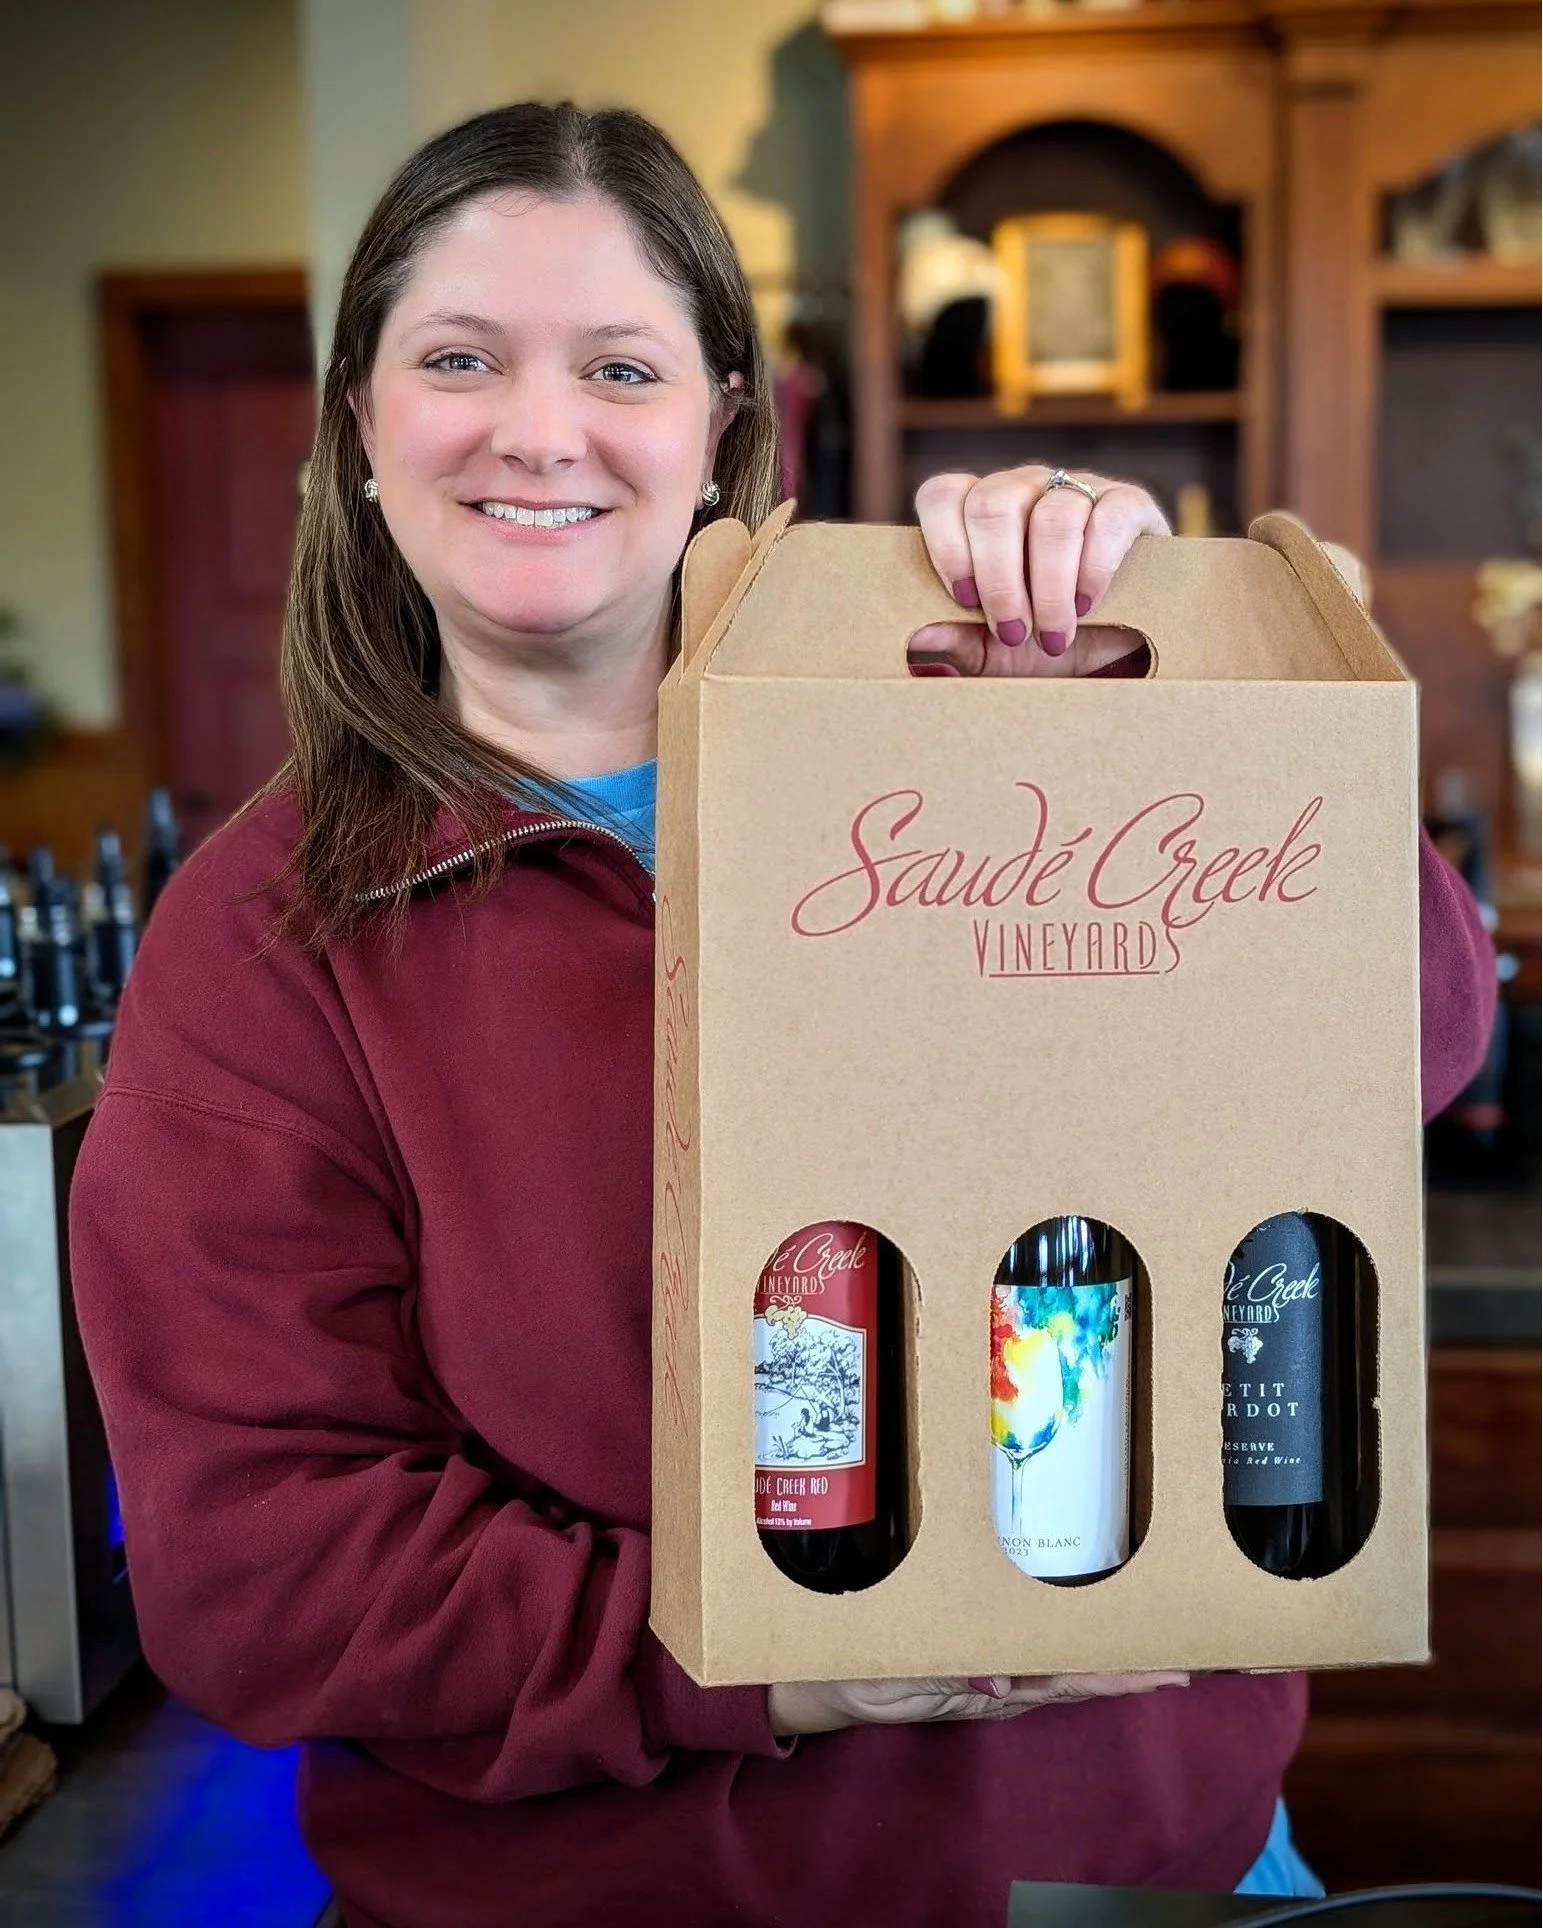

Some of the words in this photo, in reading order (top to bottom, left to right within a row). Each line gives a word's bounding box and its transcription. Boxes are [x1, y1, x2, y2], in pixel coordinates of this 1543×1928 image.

[791, 781, 1093, 937] Saudé
[1087, 792, 1323, 930] Creek
[972, 918, 1181, 978] VINEYARDS
[793, 1230, 868, 1280] Creek
[1246, 1261, 1320, 1309] Creek
[1223, 1304, 1280, 1323] NEYARDS
[1223, 1382, 1285, 1397] ETIT
[1226, 1401, 1299, 1417] RDOT
[1224, 1441, 1275, 1452] ESERVE
[1246, 1456, 1269, 1465] Red
[1274, 1456, 1301, 1465] Wine
[776, 1476, 806, 1496] CREEK
[810, 1476, 829, 1495] RED
[771, 1499, 782, 1512] Red
[783, 1499, 798, 1512] Wine
[1037, 1536, 1082, 1548] BLANC
